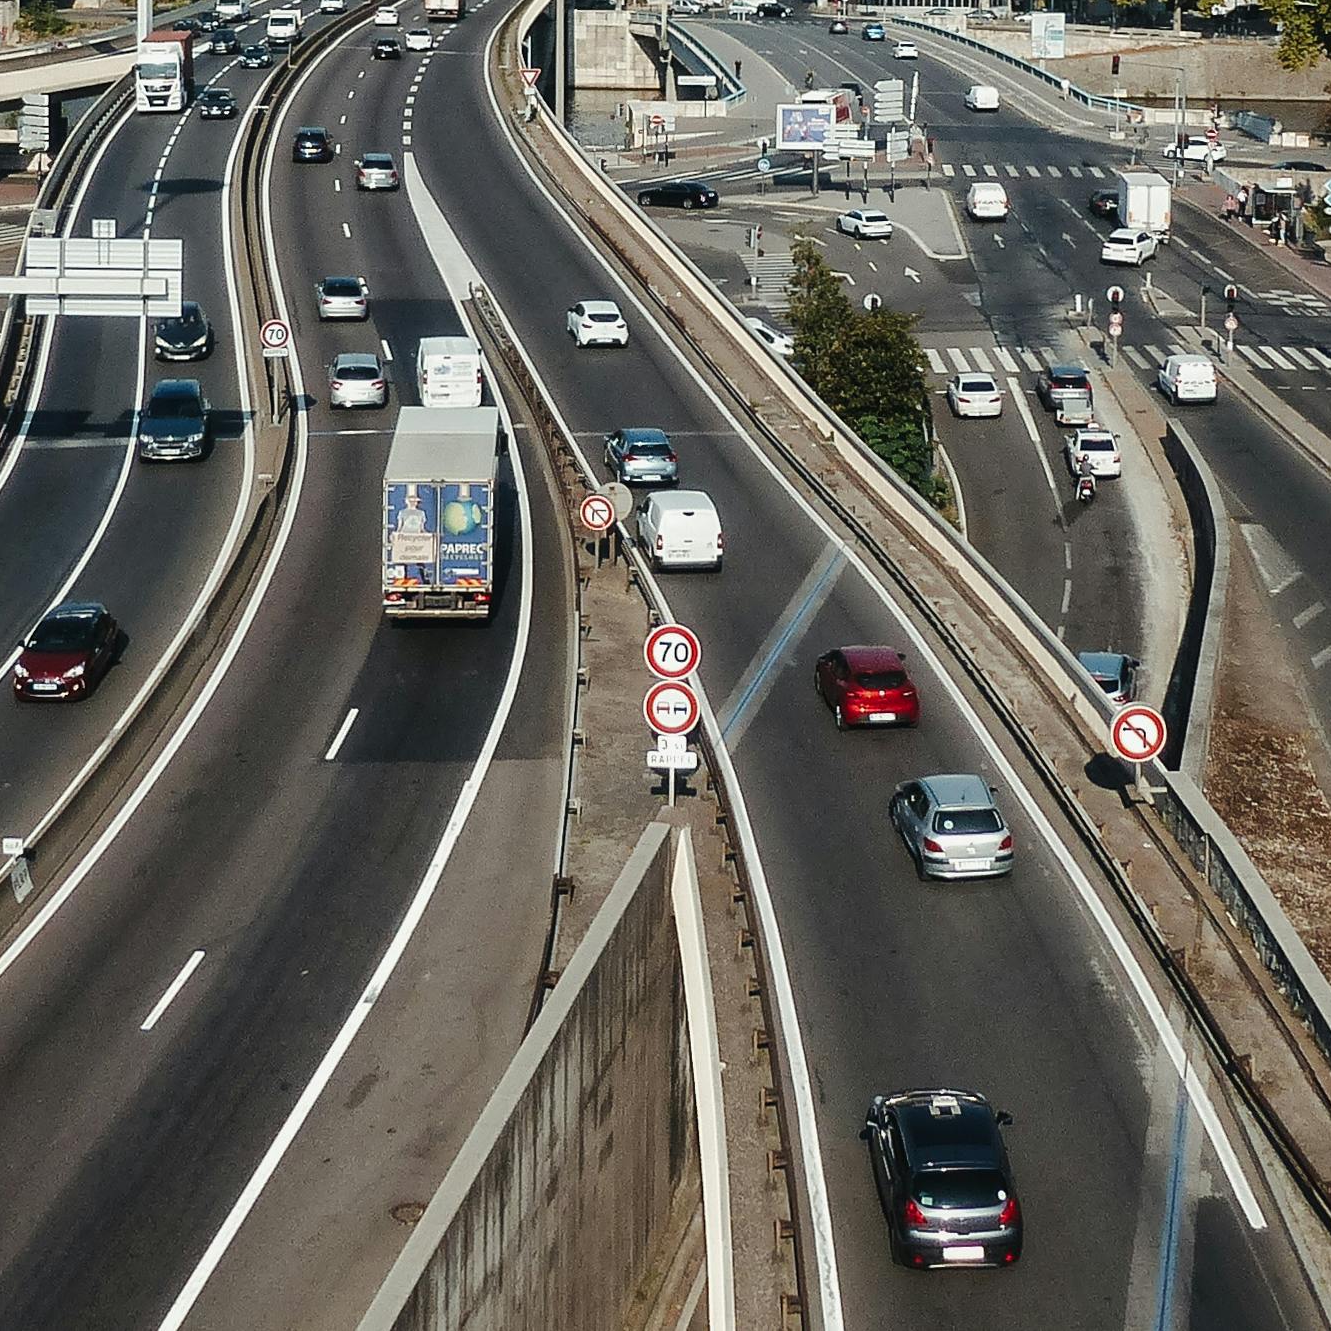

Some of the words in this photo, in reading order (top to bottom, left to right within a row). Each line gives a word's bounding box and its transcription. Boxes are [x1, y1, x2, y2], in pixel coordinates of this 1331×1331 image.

[268, 329, 285, 340] 70
[441, 543, 485, 554] PAPREC
[659, 641, 689, 663] 70
